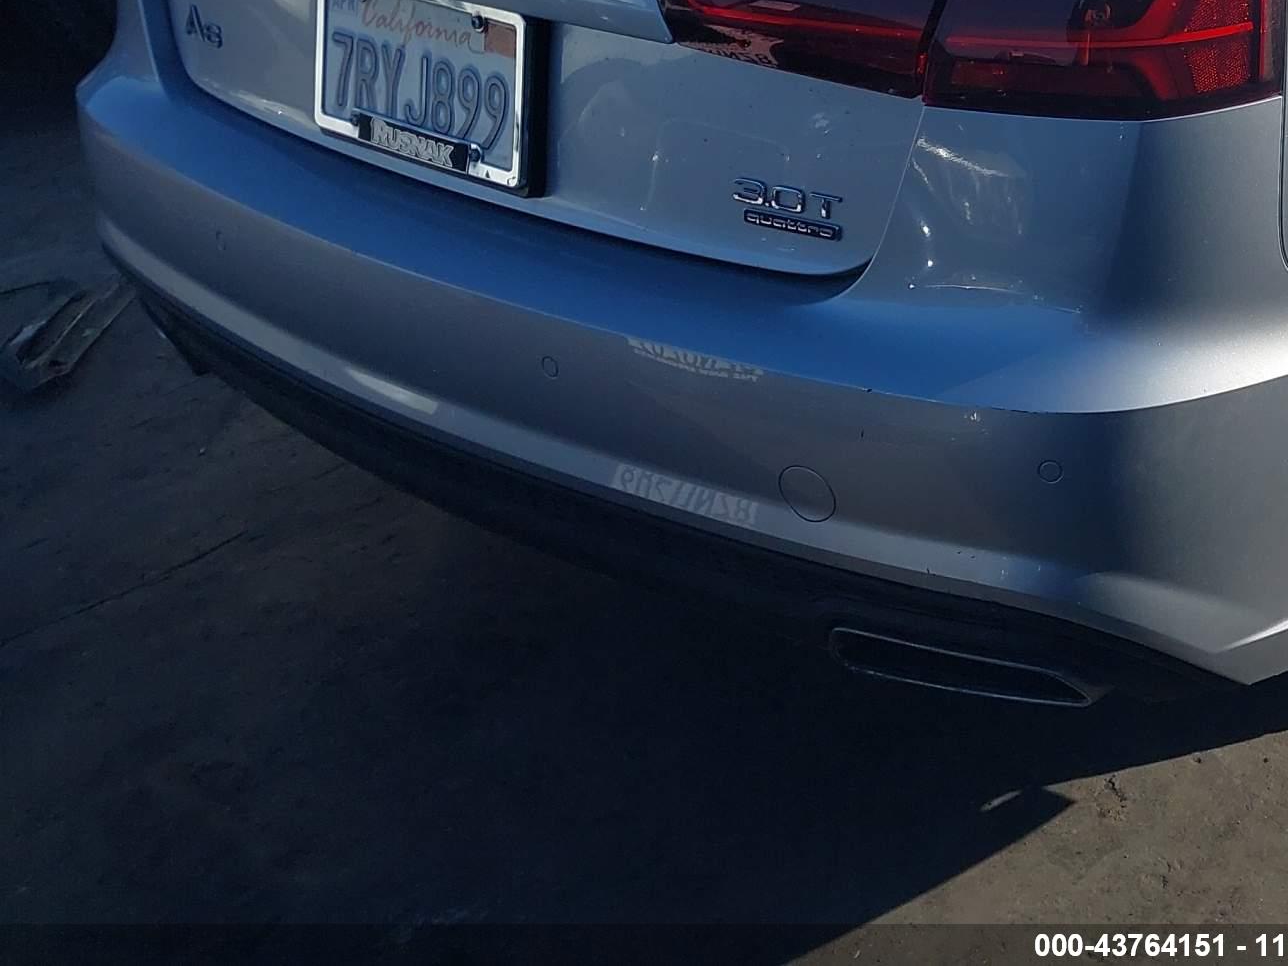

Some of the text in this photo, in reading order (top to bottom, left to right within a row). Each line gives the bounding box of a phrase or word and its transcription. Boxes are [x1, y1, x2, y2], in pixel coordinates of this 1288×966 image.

[332, 30, 509, 151] 7RYJ899
[370, 117, 453, 168] RUSNAK
[746, 212, 834, 238] quattro
